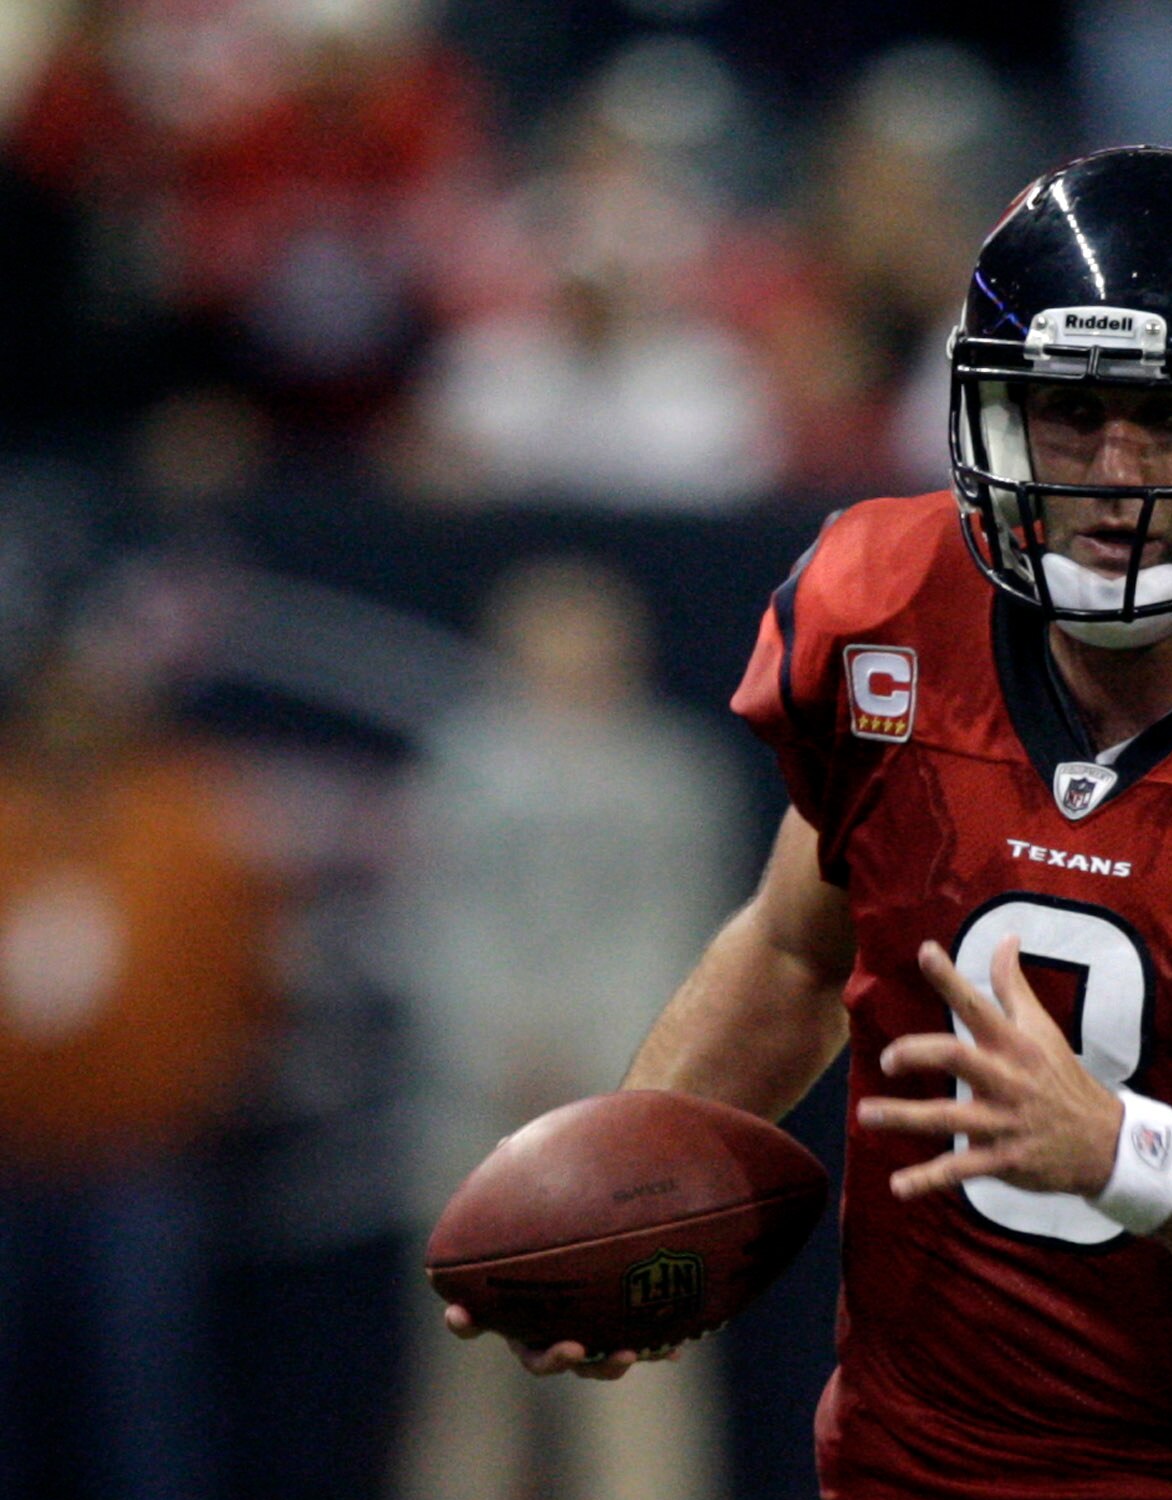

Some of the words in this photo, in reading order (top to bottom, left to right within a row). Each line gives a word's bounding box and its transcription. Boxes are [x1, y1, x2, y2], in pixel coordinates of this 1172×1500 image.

[1065, 314, 1133, 332] Riddell
[852, 652, 911, 717] C
[1006, 838, 1132, 878] TEXANS
[630, 1262, 694, 1305] NFL
